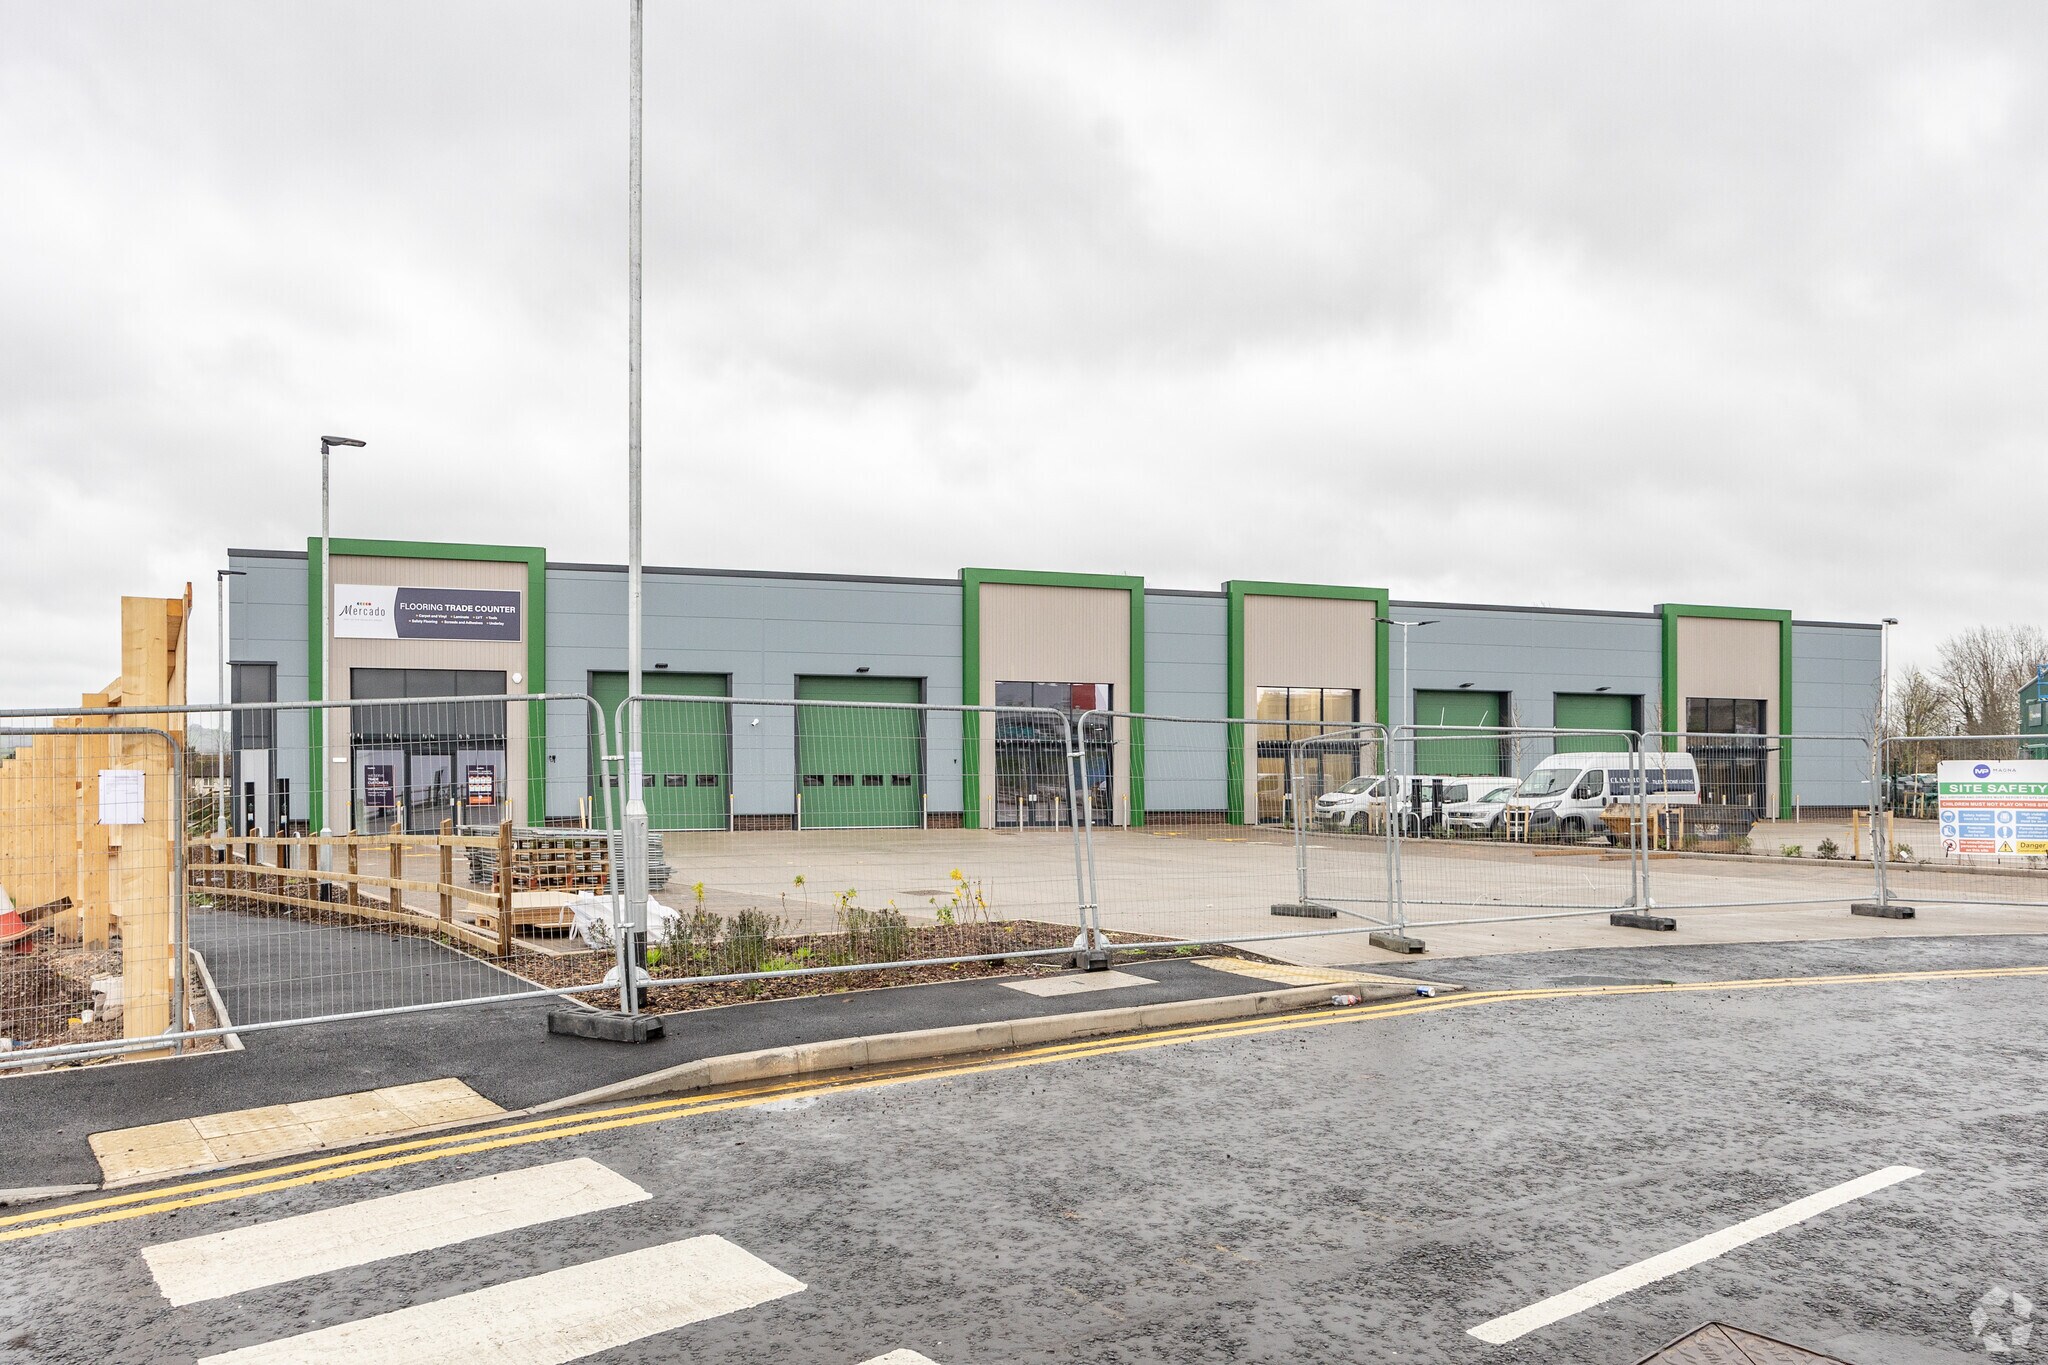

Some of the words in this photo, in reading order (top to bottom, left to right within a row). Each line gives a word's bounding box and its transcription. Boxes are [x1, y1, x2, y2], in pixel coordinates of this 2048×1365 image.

[339, 605, 386, 617] Mercado
[400, 603, 443, 611] FLOORING
[445, 604, 474, 612] TRADE
[475, 605, 516, 614] COUNTER
[1949, 784, 1983, 793] SITE
[1987, 784, 2048, 794] SAFETY
